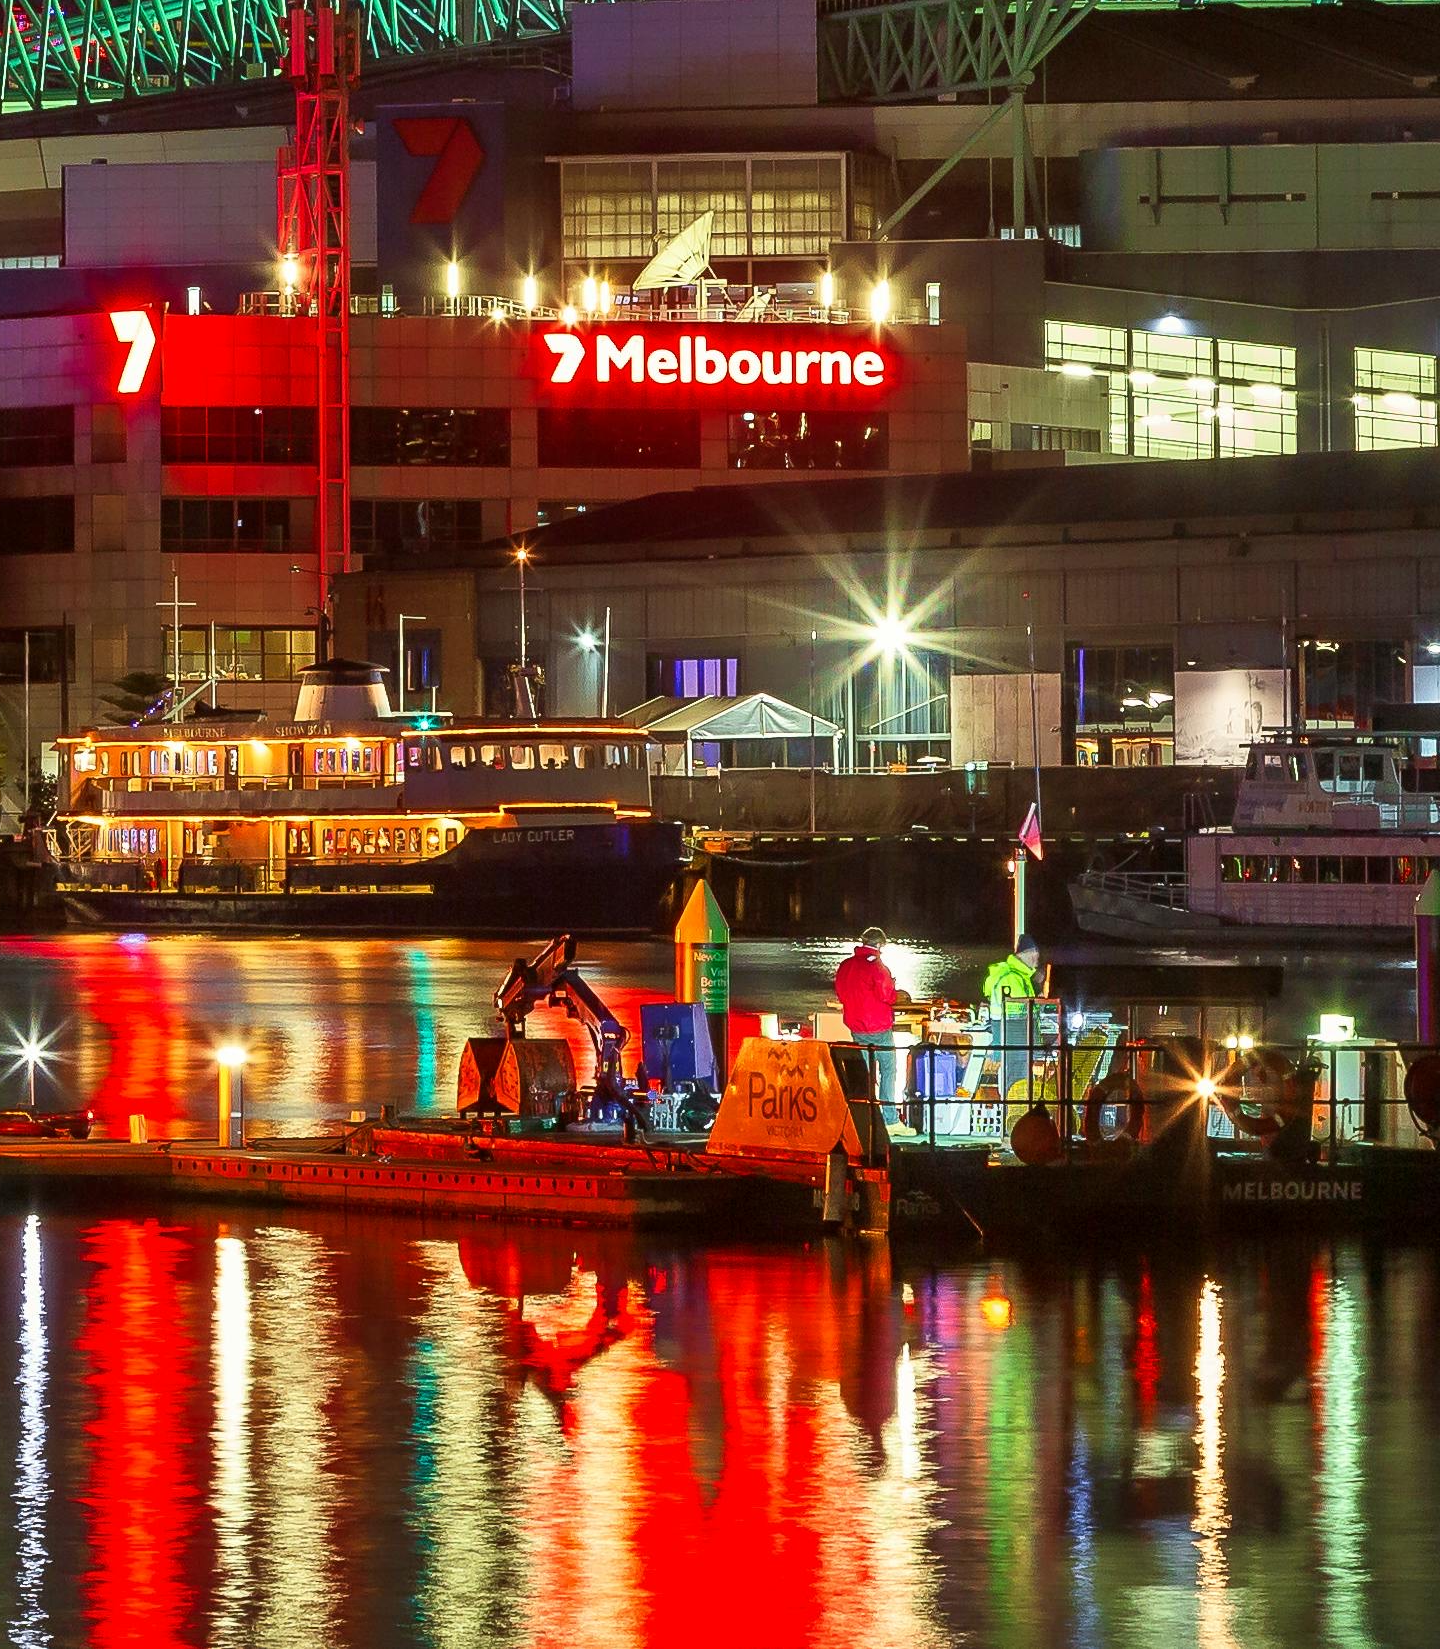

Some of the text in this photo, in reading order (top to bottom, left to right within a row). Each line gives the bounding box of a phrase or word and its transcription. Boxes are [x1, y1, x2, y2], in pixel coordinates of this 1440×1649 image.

[392, 117, 487, 224] 7
[109, 310, 156, 393] 7
[544, 333, 885, 386] 7 Melbourne
[492, 829, 576, 844] LADY CUTLER
[748, 1071, 818, 1123] Parks
[1221, 1180, 1363, 1201] MELBOURNE
